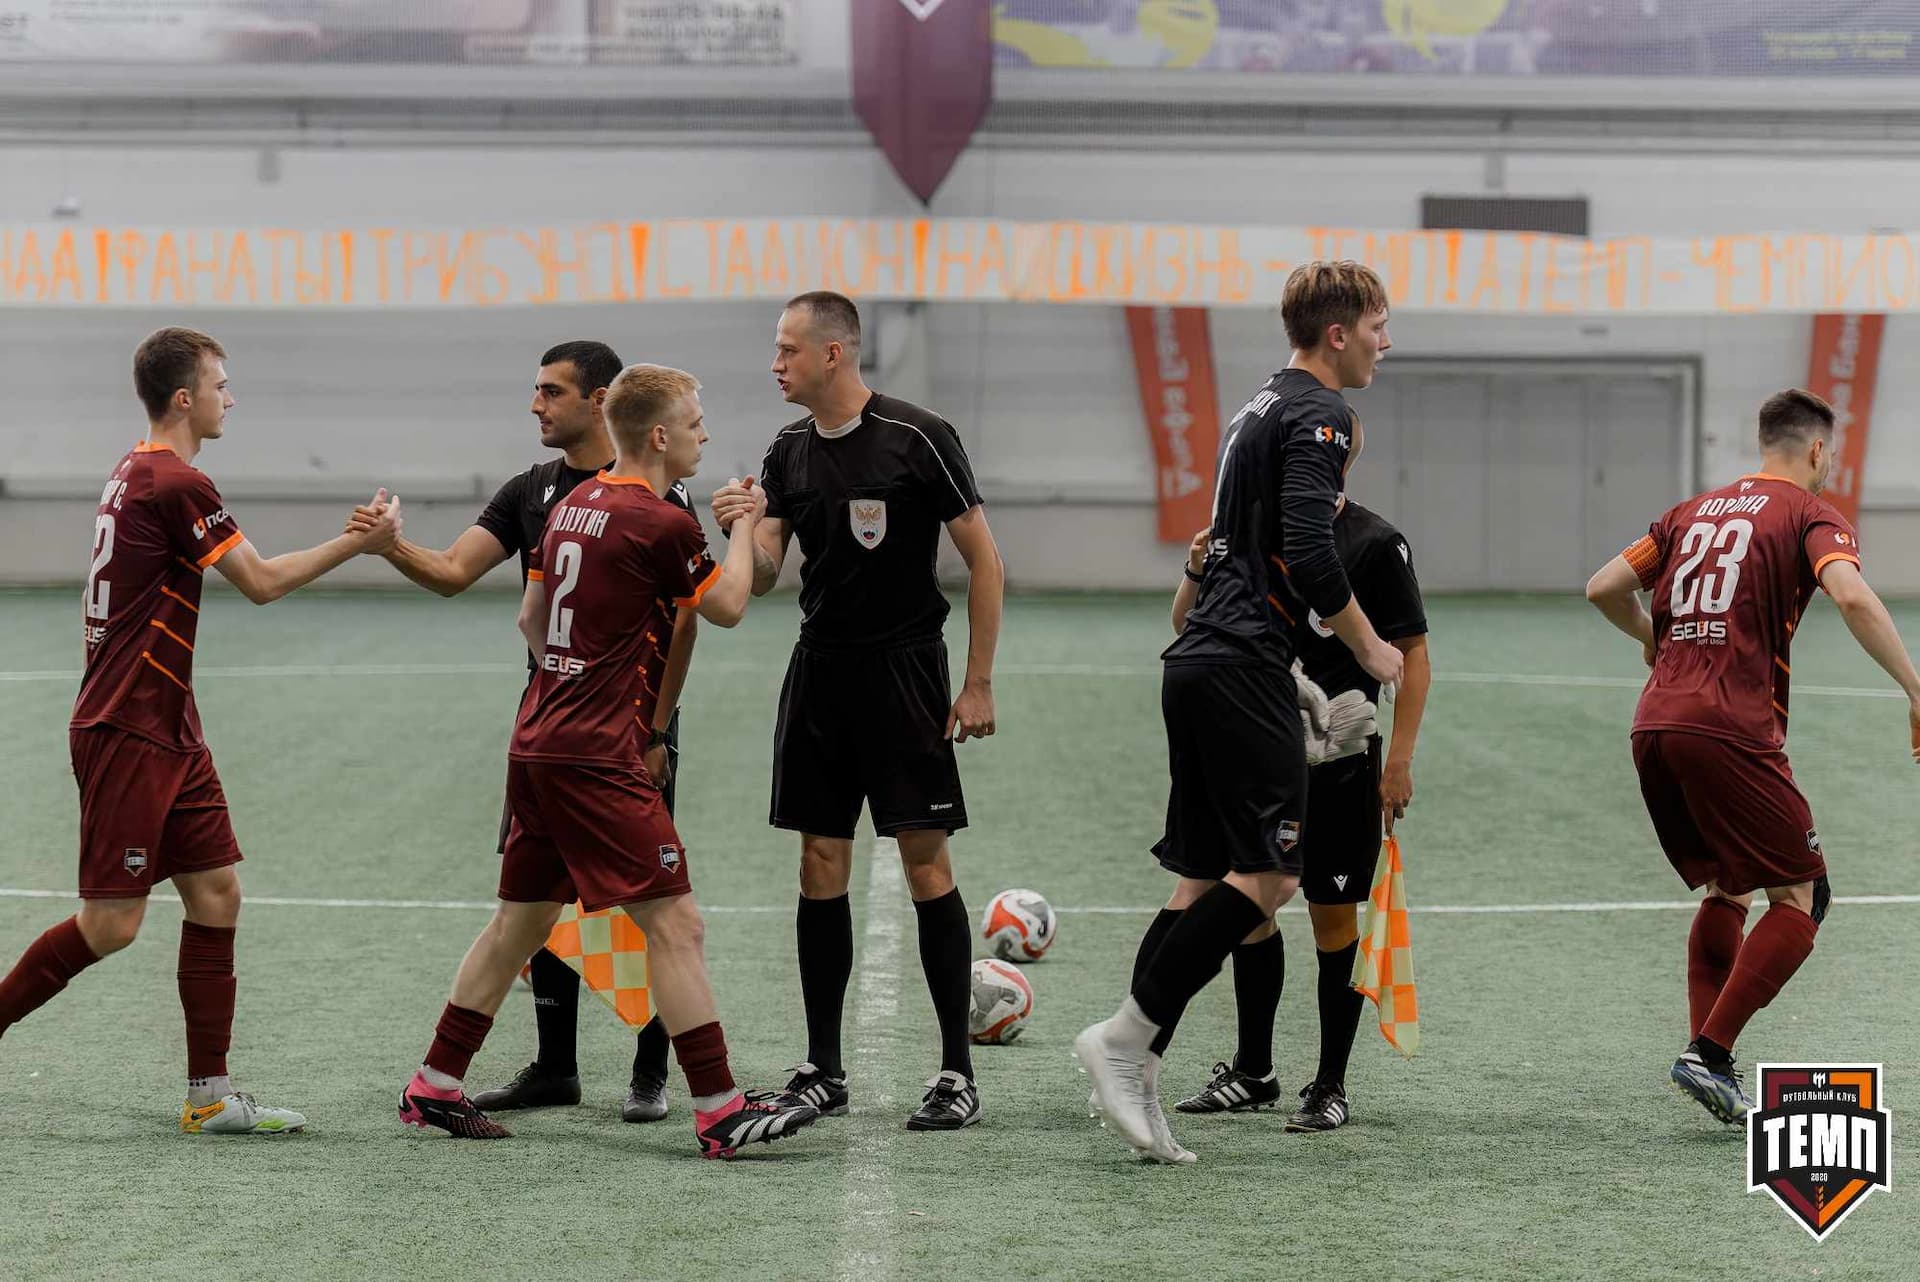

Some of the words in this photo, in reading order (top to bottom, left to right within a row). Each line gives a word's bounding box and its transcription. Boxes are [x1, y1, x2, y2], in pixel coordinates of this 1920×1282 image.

[1692, 233, 1920, 313] ЧЕМПИО
[546, 541, 583, 649] 2
[1670, 518, 1753, 618] 23
[541, 653, 586, 675] EUS
[1671, 620, 1727, 641] SEUS
